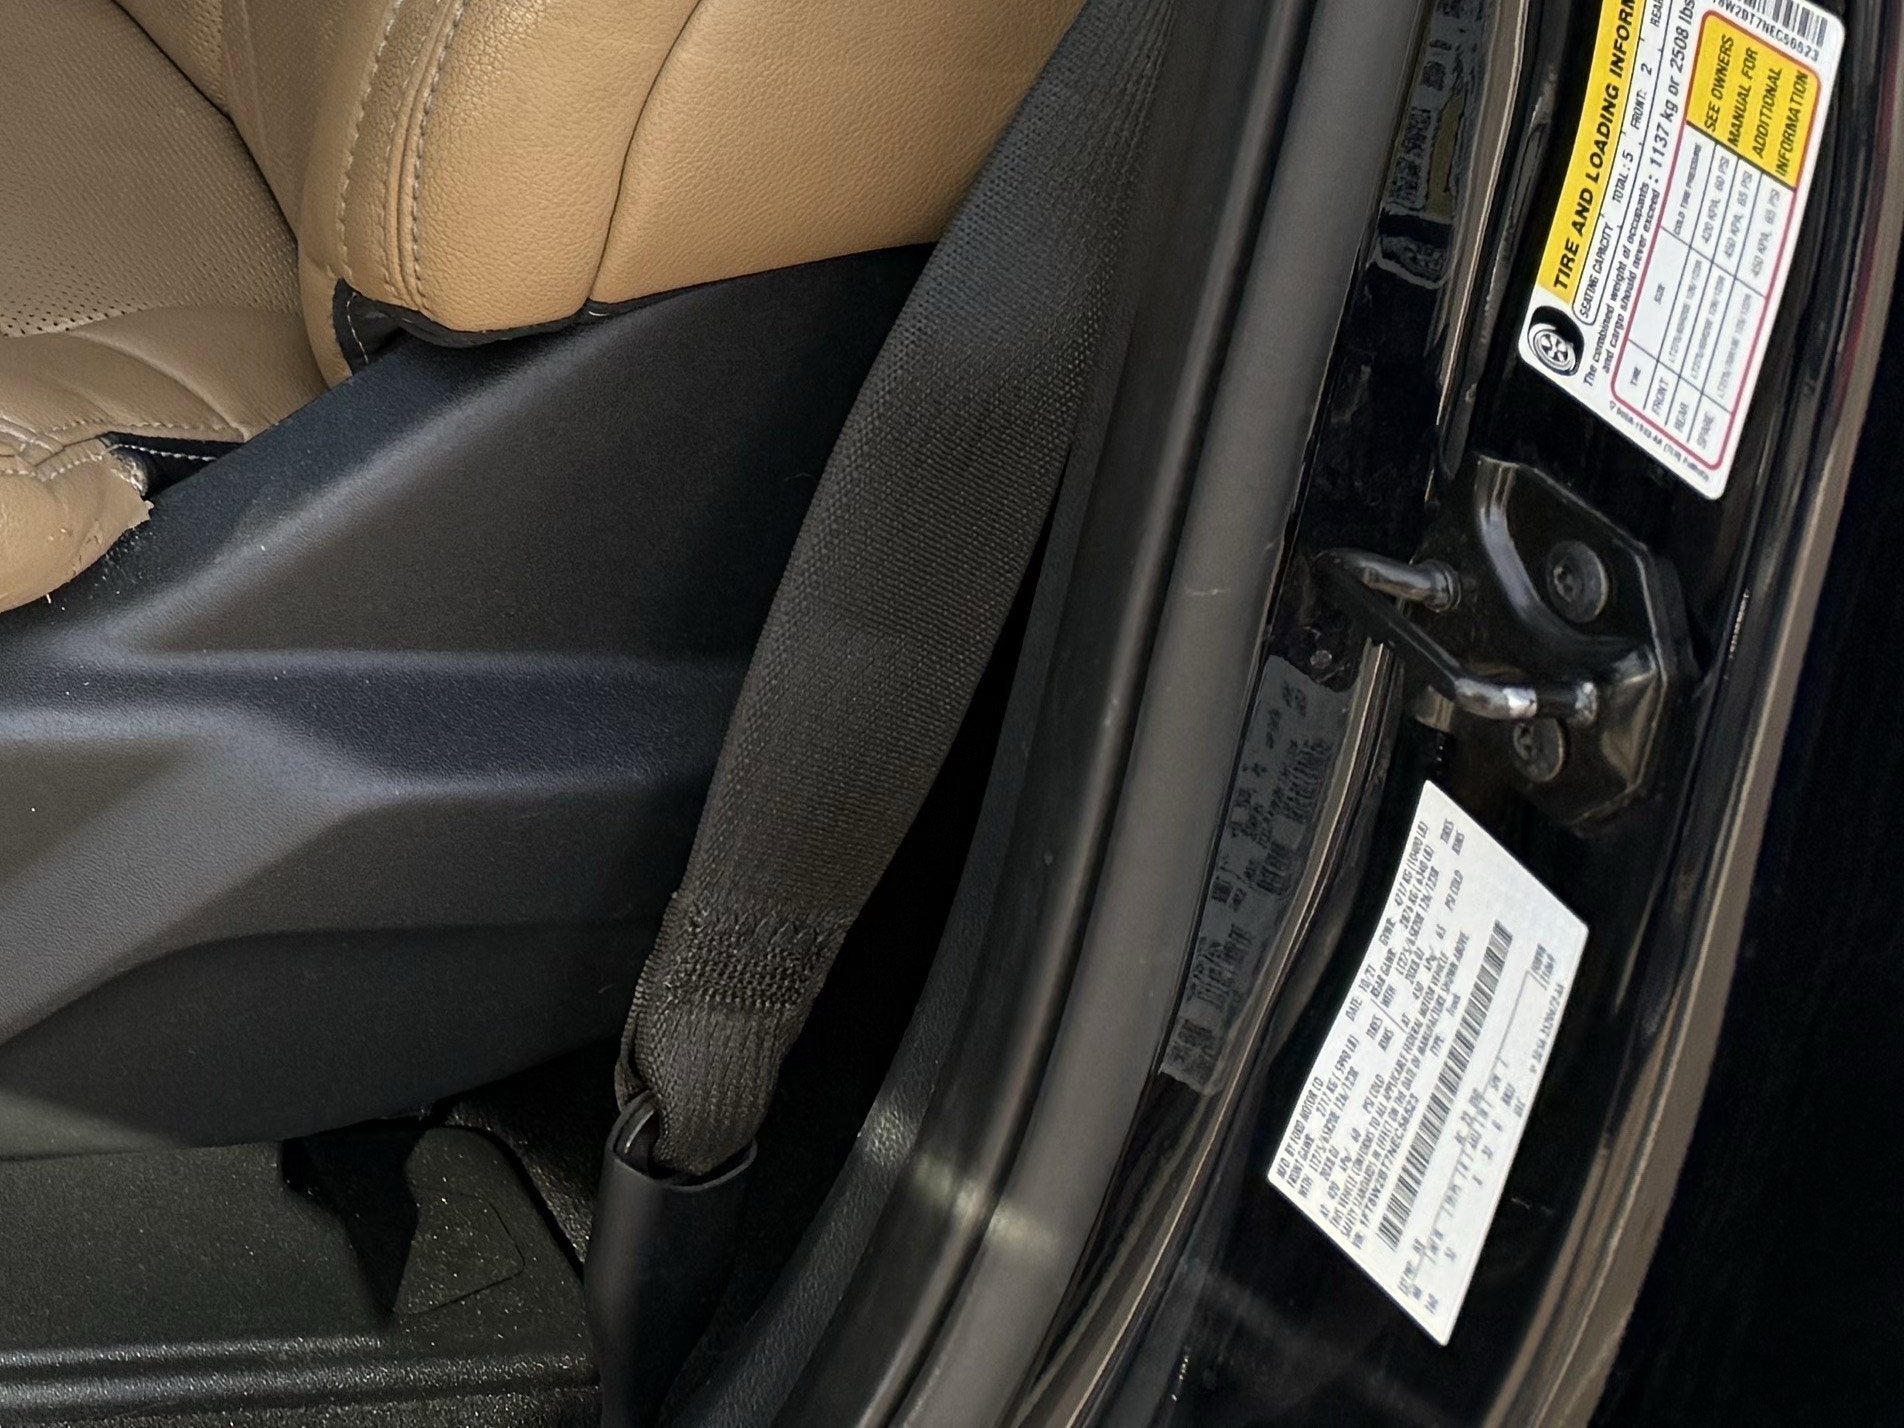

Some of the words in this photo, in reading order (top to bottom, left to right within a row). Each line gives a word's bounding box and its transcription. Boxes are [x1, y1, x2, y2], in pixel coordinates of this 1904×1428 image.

[1640, 61, 1652, 76] 2
[1670, 24, 1689, 74] 2508
[1710, 33, 1734, 100] OWNERS
[1659, 97, 1678, 124] kg
[1666, 75, 1680, 96] or
[1726, 79, 1751, 147] MANUAL
[1740, 46, 1758, 80] FOR
[1748, 62, 1782, 158] ADDITIONAL
[1702, 101, 1720, 132] SEE
[1773, 68, 1809, 177] INFORMATION
[1622, 148, 1633, 163] 5
[1648, 121, 1670, 170] 1137
[1553, 234, 1579, 295] TIRE
[1569, 183, 1594, 238] AND
[1584, 80, 1620, 184] LOADING
[1579, 273, 1600, 320] SEATING
[1591, 220, 1614, 275] CAPACITY
[1583, 361, 1597, 388] The
[1590, 301, 1614, 365] combined
[1606, 257, 1627, 303] weight
[1620, 243, 1630, 259] of
[1625, 179, 1650, 246] occupants
[1600, 347, 1614, 375] and
[1608, 311, 1625, 350] cargo
[1618, 268, 1636, 313] should
[1631, 232, 1647, 270] never
[1640, 186, 1659, 233] exceed
[1651, 375, 1669, 417] FRONT
[1673, 399, 1689, 433] REAR
